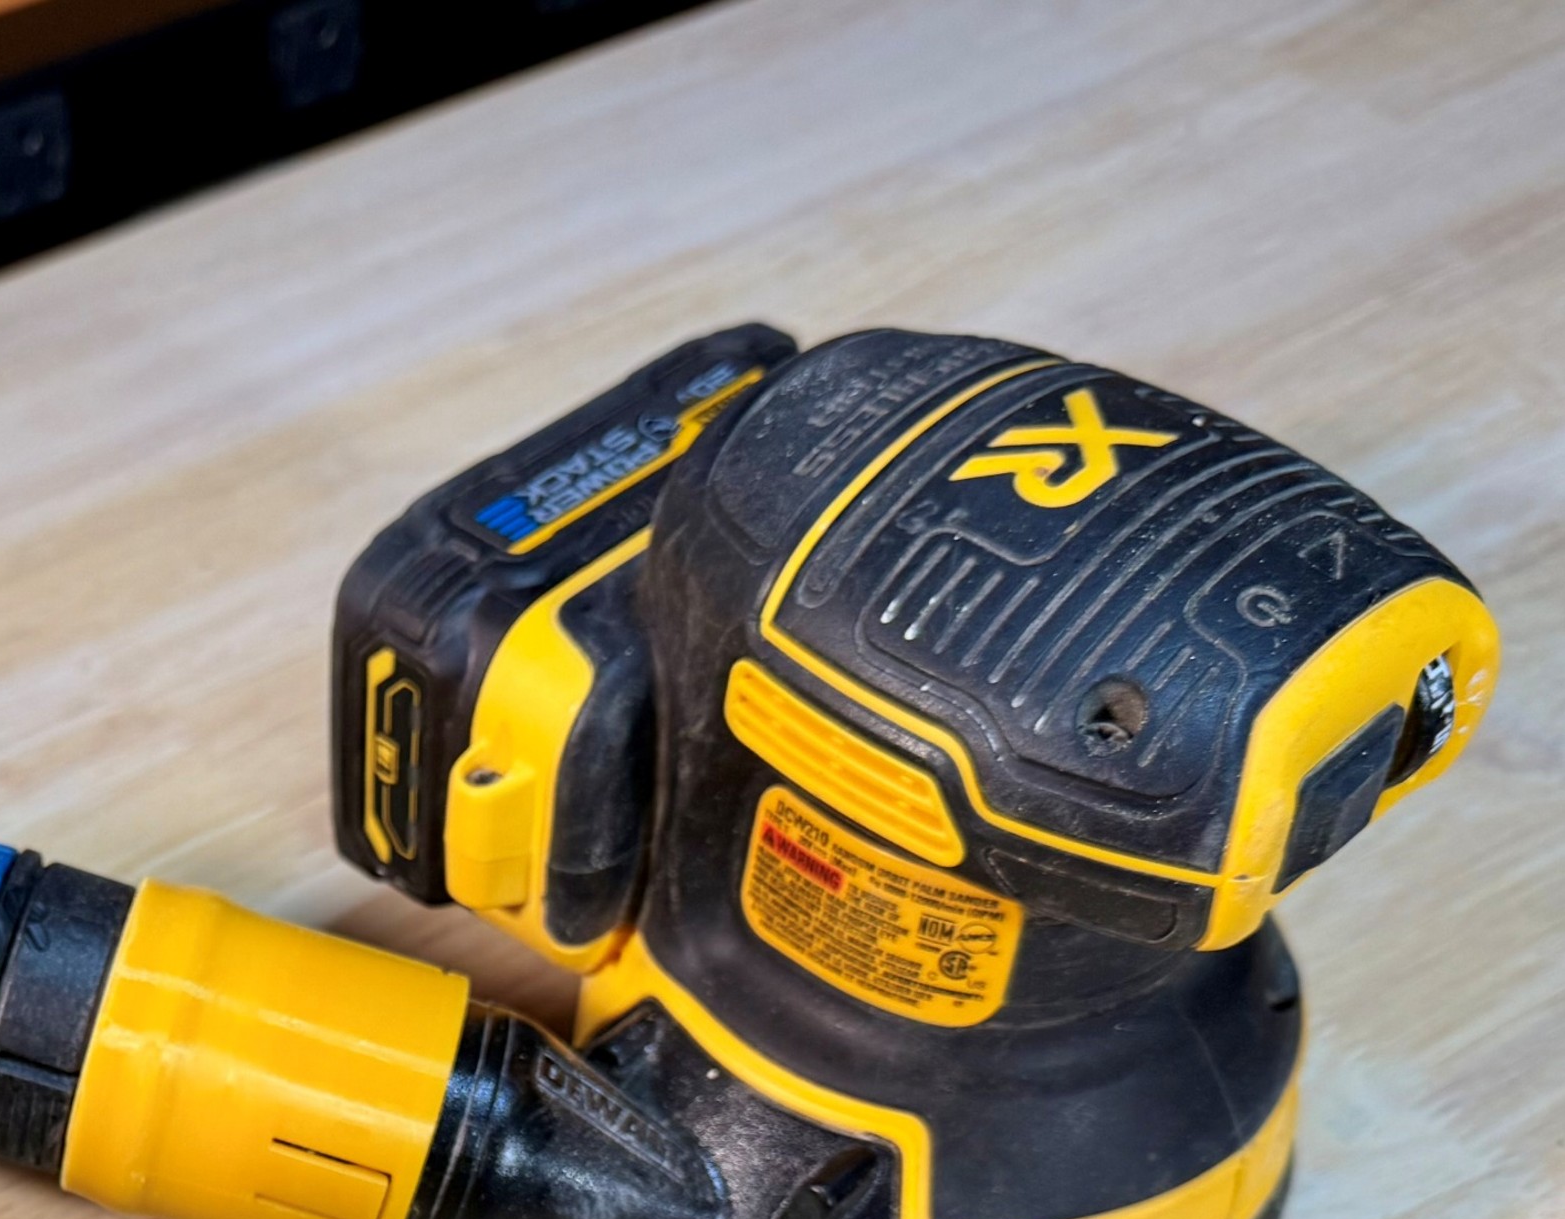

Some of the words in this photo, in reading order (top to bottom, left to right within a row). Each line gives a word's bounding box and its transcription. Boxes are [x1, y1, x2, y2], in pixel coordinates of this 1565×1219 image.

[515, 425, 637, 504] STACK
[529, 441, 663, 524] POWER
[948, 388, 1180, 509] XR
[776, 799, 830, 848] DCW210
[775, 834, 843, 892] WARNING
[919, 917, 956, 942] NOM
